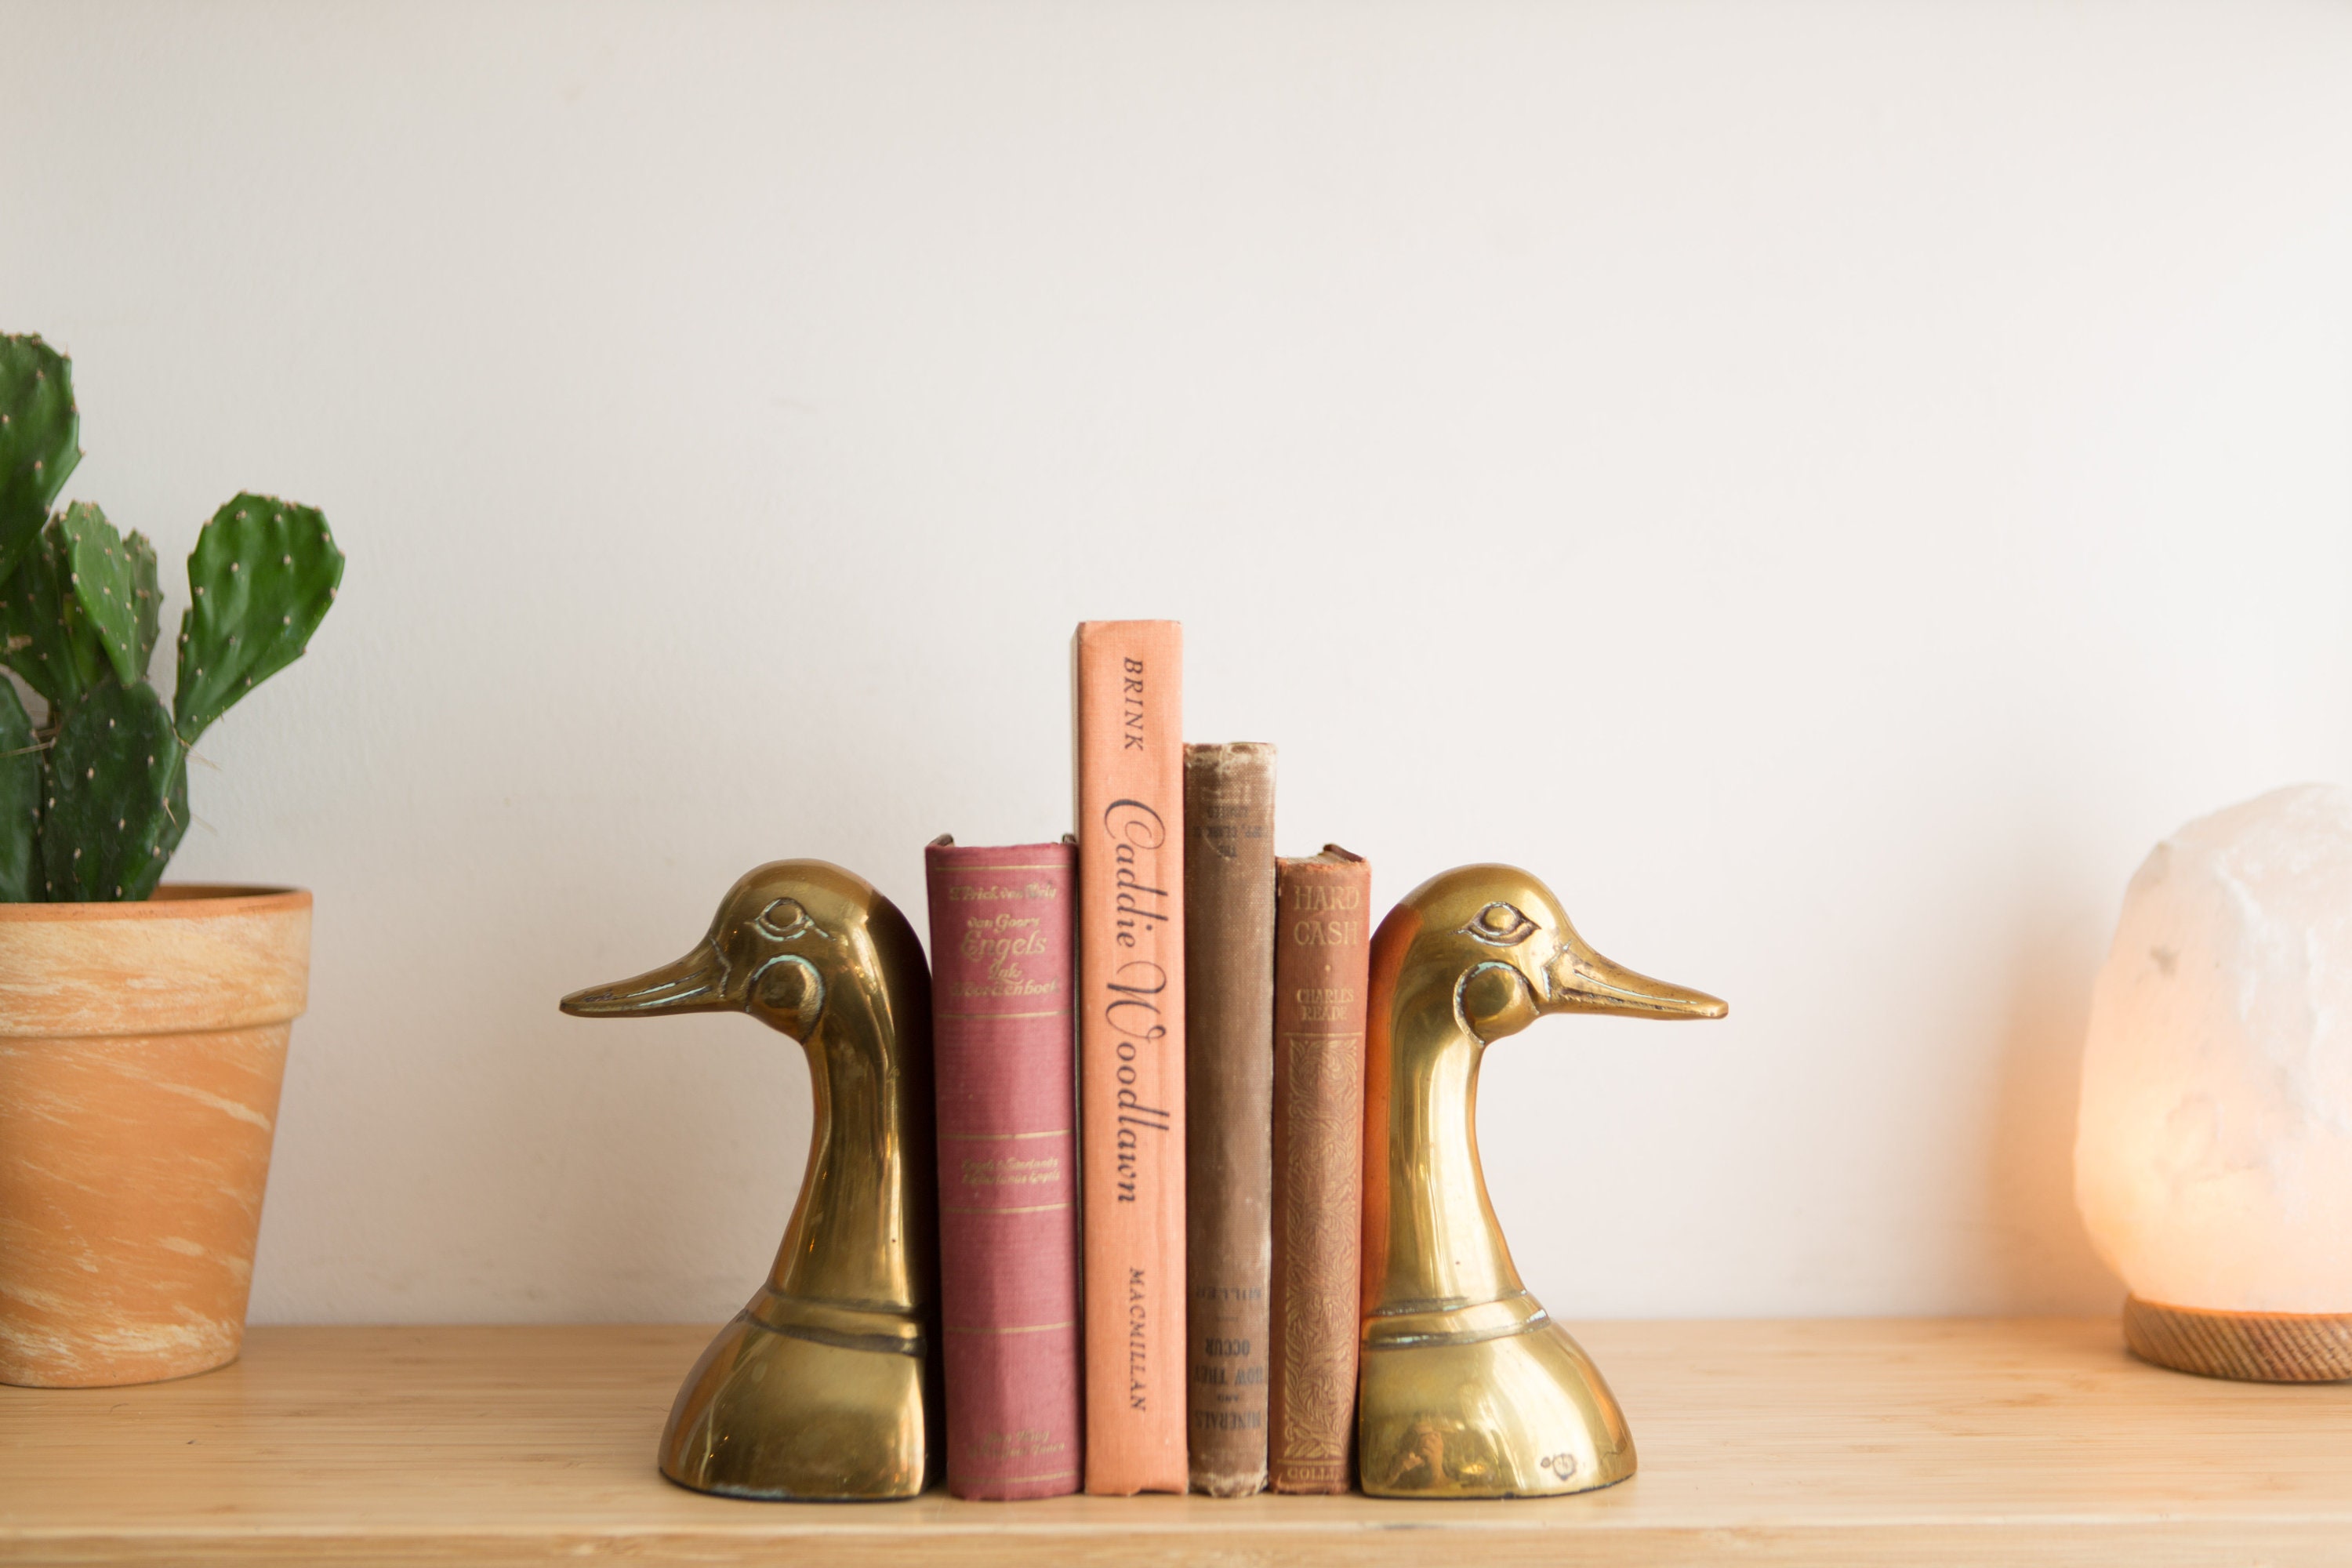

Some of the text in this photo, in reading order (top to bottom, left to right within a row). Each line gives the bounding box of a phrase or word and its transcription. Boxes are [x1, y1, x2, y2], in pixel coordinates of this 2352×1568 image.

[1123, 657, 1143, 751] BRINK
[1294, 885, 1359, 910] HARD
[960, 929, 1047, 965] Engels
[1294, 920, 1359, 946] CASH
[1104, 799, 1170, 1203] Caddie Woodlawn
[1297, 988, 1354, 1003] CHARLES
[1130, 1267, 1146, 1412] MACMILLAN
[1205, 1338, 1250, 1357] OCCUR
